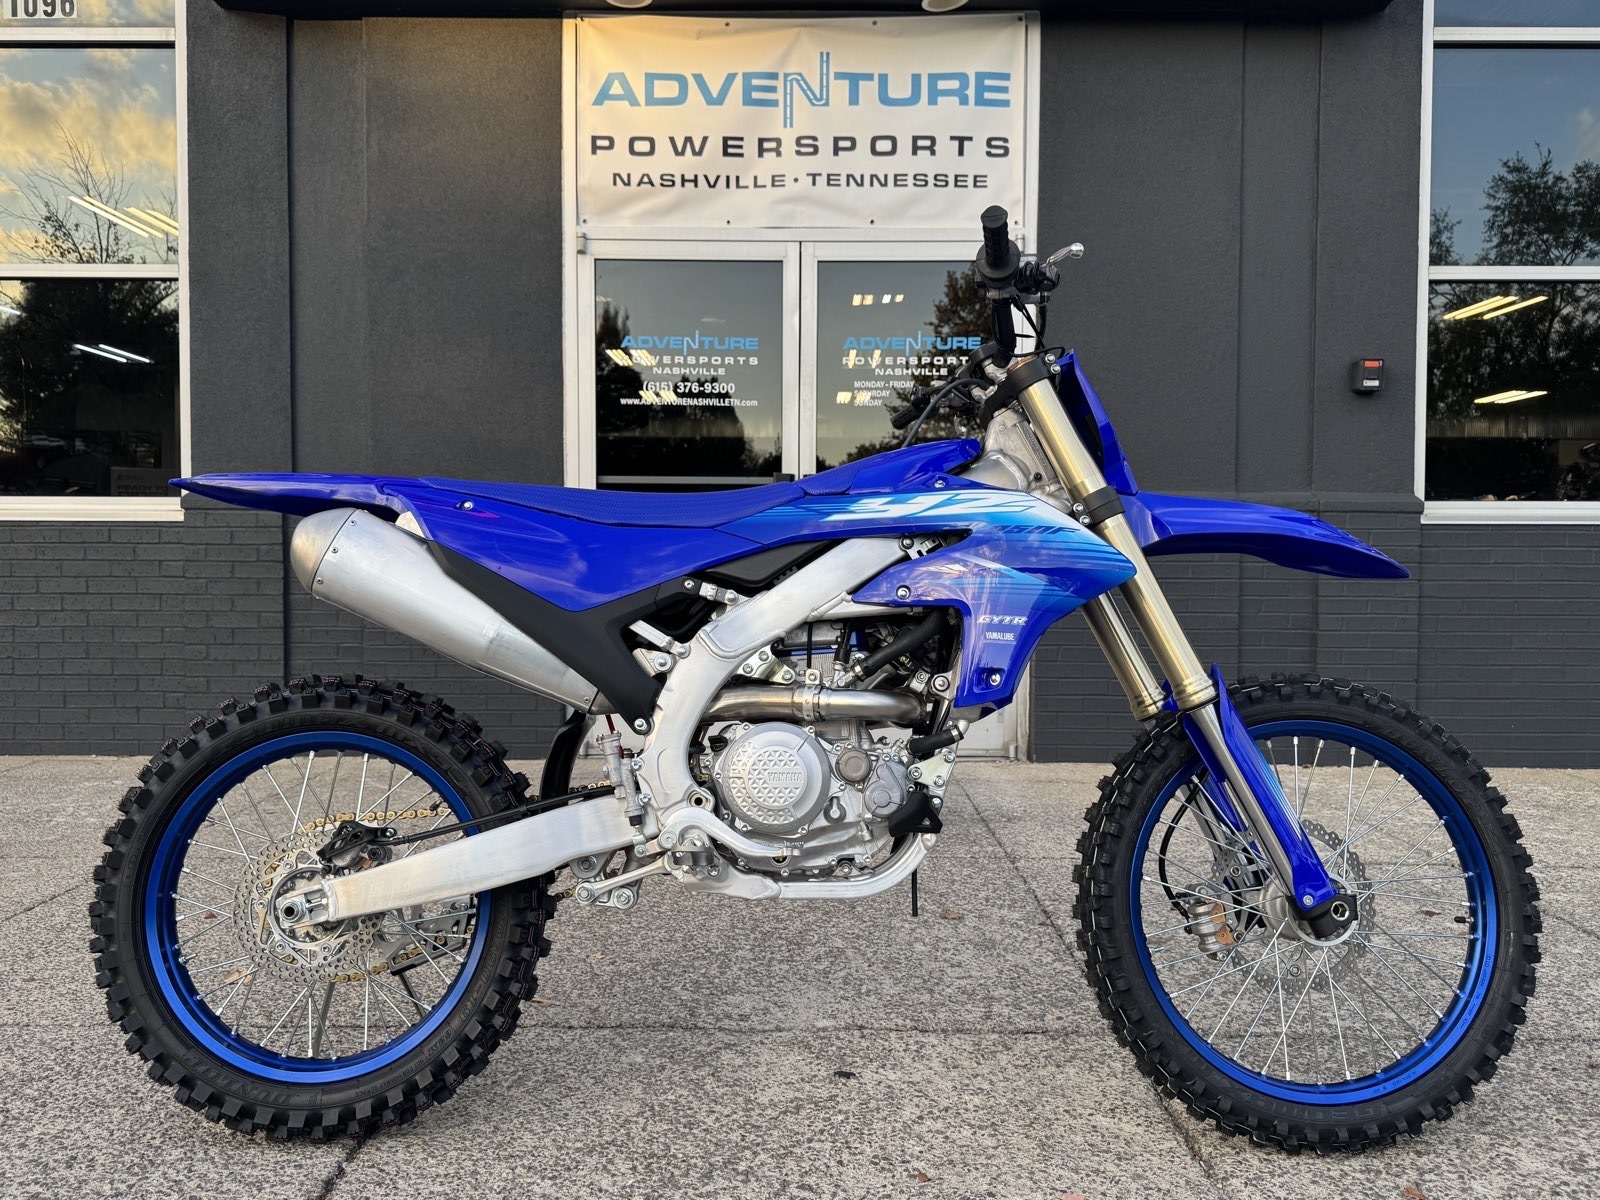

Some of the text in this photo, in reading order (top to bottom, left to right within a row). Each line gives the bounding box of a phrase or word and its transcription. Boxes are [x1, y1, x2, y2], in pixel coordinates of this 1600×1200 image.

[10, 0, 75, 18] 1096
[591, 51, 1011, 129] ADVENTURE
[590, 135, 1010, 159] POWERSPORTS
[612, 172, 989, 189] NASHVILLE TENNESSEE
[620, 330, 759, 355] ADVENTURE
[842, 330, 982, 356] ADVENTURE
[623, 355, 759, 365] OERSPORTS
[842, 356, 969, 365] POWERSPORT
[652, 366, 726, 375] NASHVILLE
[875, 368, 948, 376] NASHVILLE
[642, 380, 736, 394] (615) 376-9300
[854, 380, 885, 388] MONDAY
[889, 380, 915, 389] FRIDAY
[977, 614, 1028, 626] GYTR
[985, 631, 1015, 641] YAMALUBE
[767, 771, 803, 782] YAMAHA
